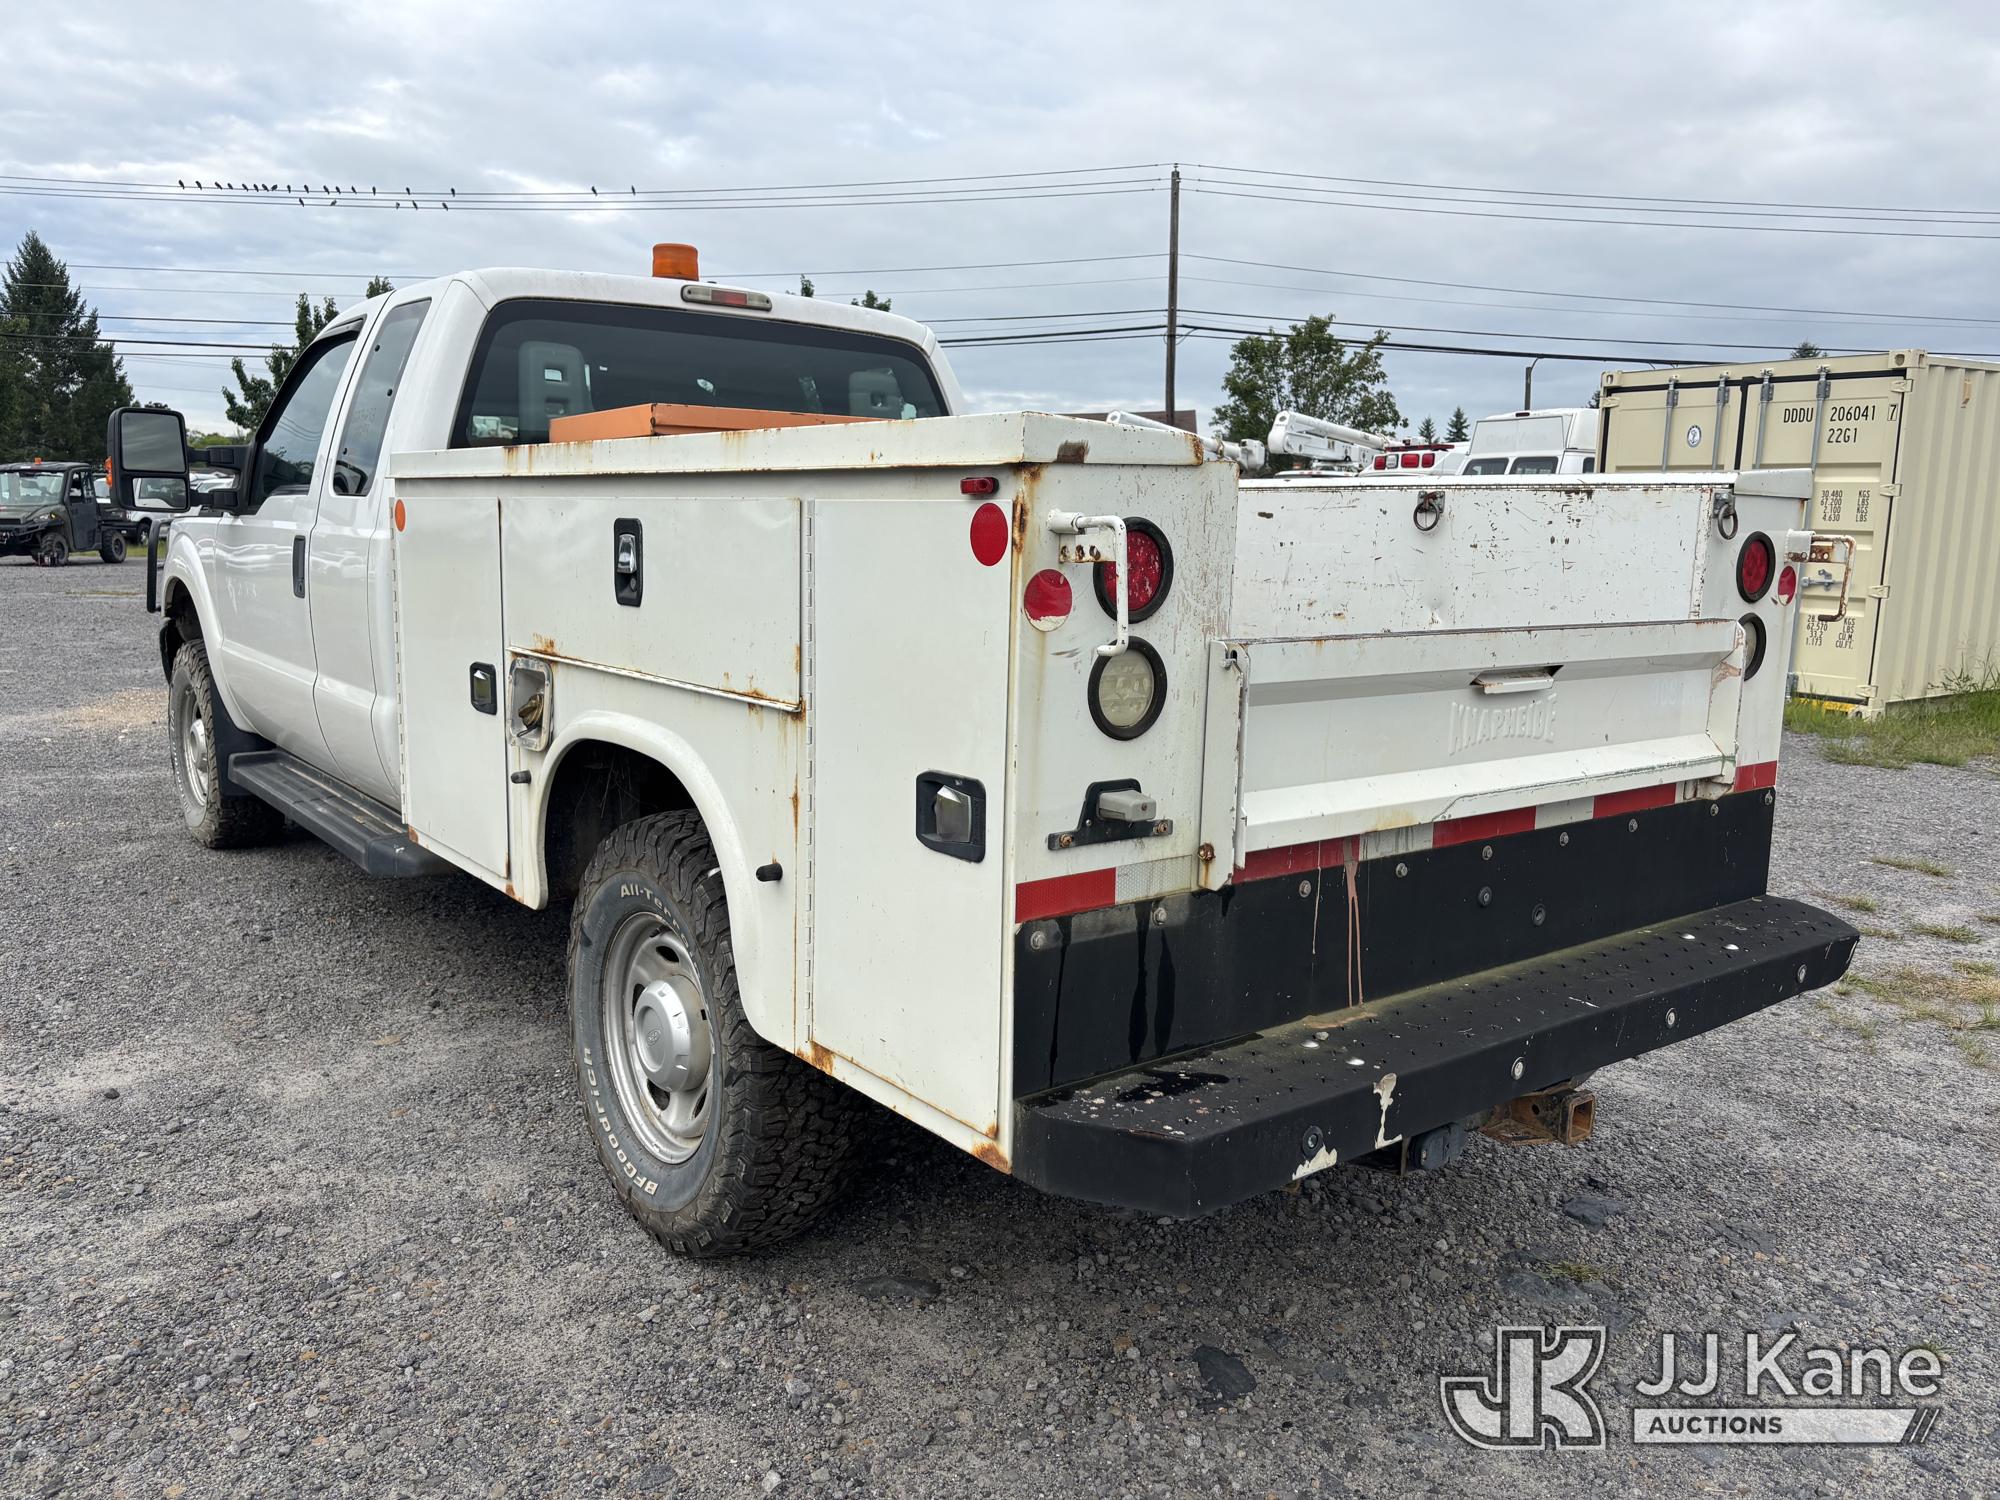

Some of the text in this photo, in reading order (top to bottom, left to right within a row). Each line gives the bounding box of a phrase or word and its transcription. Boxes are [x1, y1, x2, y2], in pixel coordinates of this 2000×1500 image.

[1783, 404, 1897, 423] DDDU 206041 7
[1827, 427, 1857, 443] 22G1
[1858, 490, 1871, 498] KGS
[1857, 498, 1869, 506] LBS
[1857, 506, 1869, 514] KGS
[1855, 514, 1867, 522] LBS
[1844, 617, 1855, 625] KGS
[1843, 625, 1855, 634] LBS
[1449, 693, 1557, 756] KNAPHEIDE
